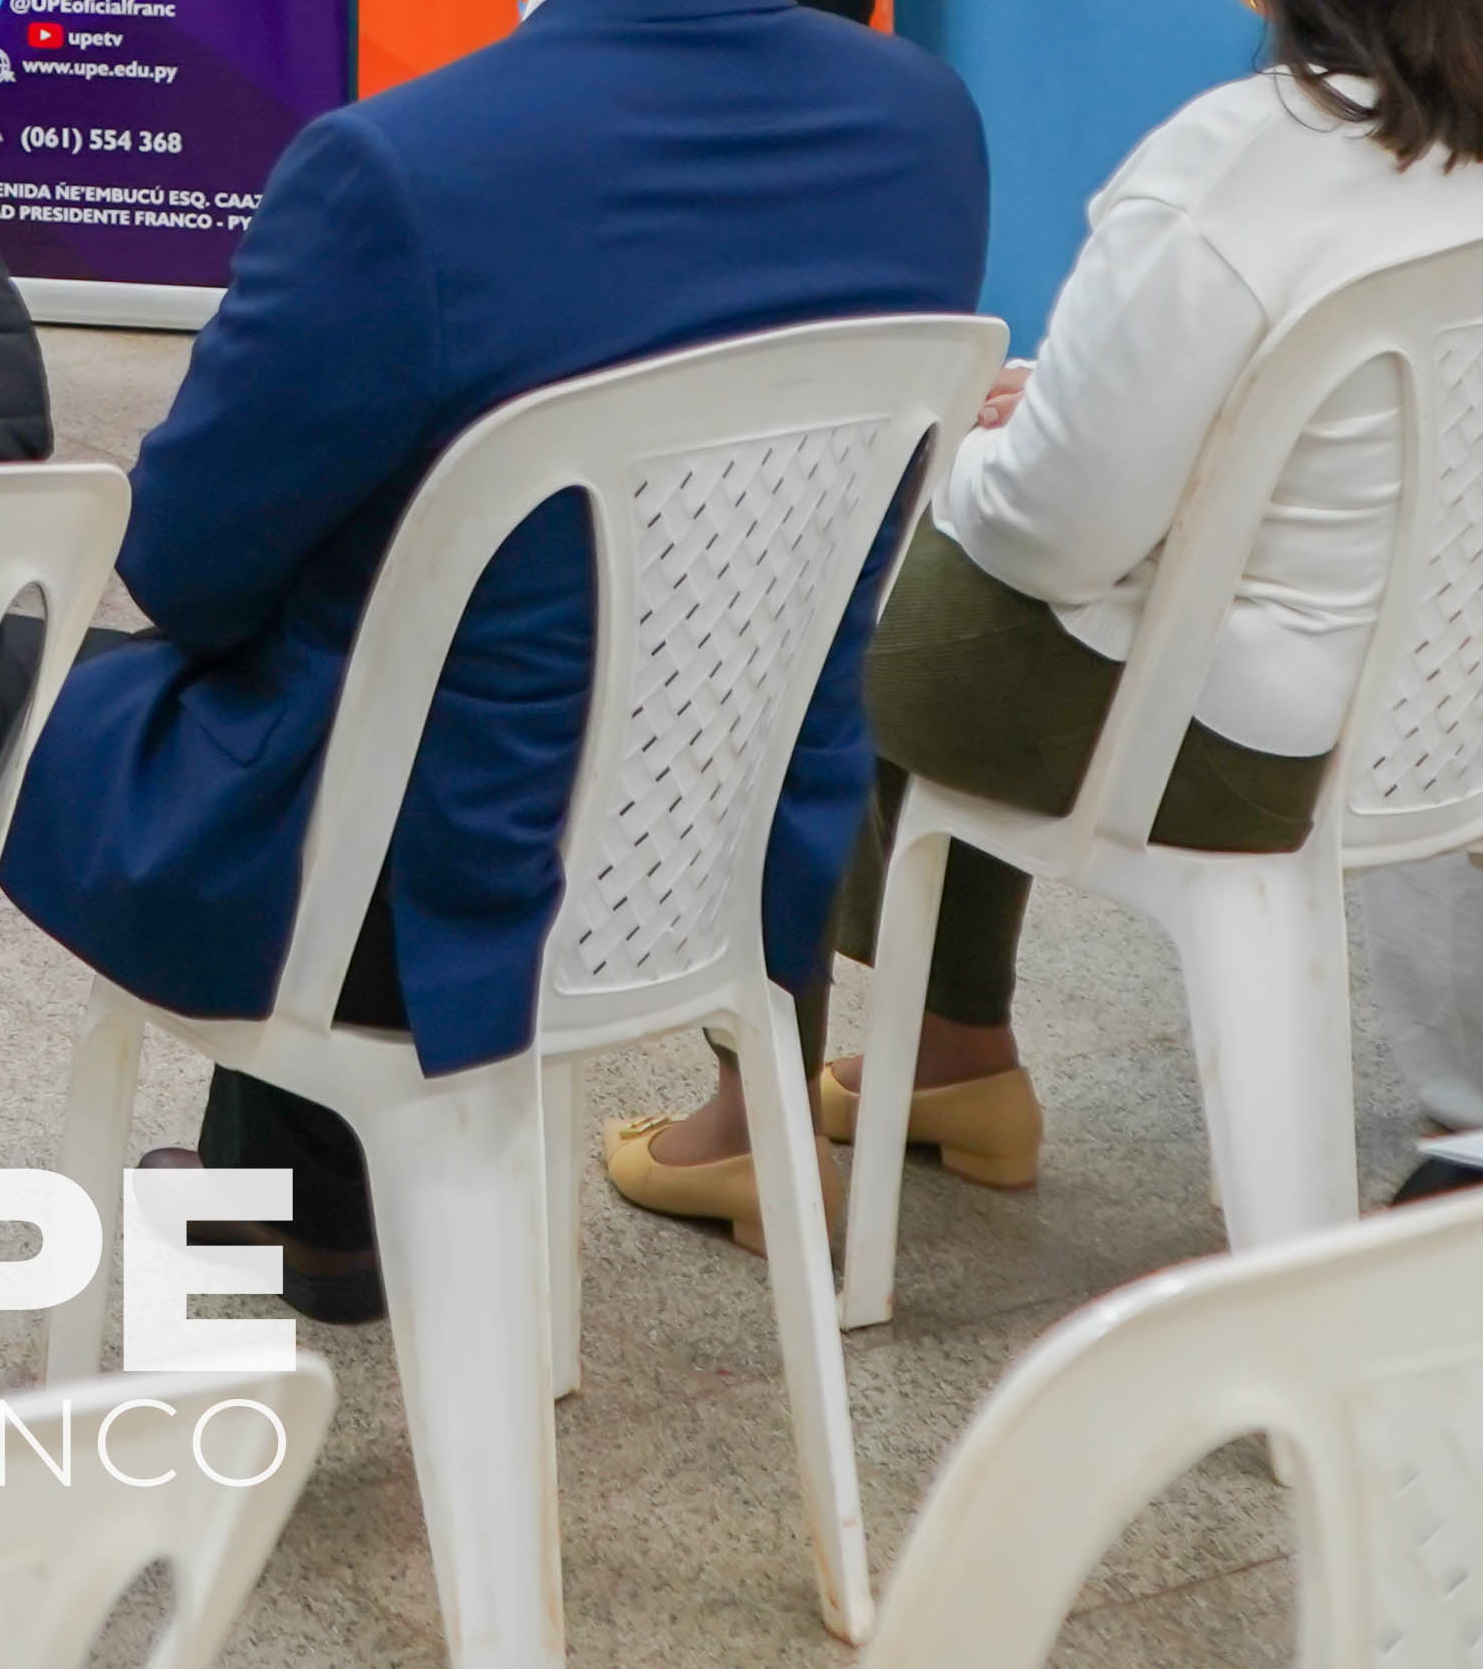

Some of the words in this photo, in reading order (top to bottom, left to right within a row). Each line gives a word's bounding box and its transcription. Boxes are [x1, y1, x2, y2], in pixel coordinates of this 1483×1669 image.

[69, 33, 122, 49] upetv
[23, 61, 177, 83] www.upe.edu.py
[21, 127, 82, 154] (061)
[90, 129, 131, 150] 554
[139, 131, 181, 153] 368
[56, 182, 164, 204] ÑE'EMBUCÚ
[169, 191, 210, 209] ESQ.
[20, 206, 129, 225] PRESIDENTE
[135, 211, 212, 228] FRANCO
